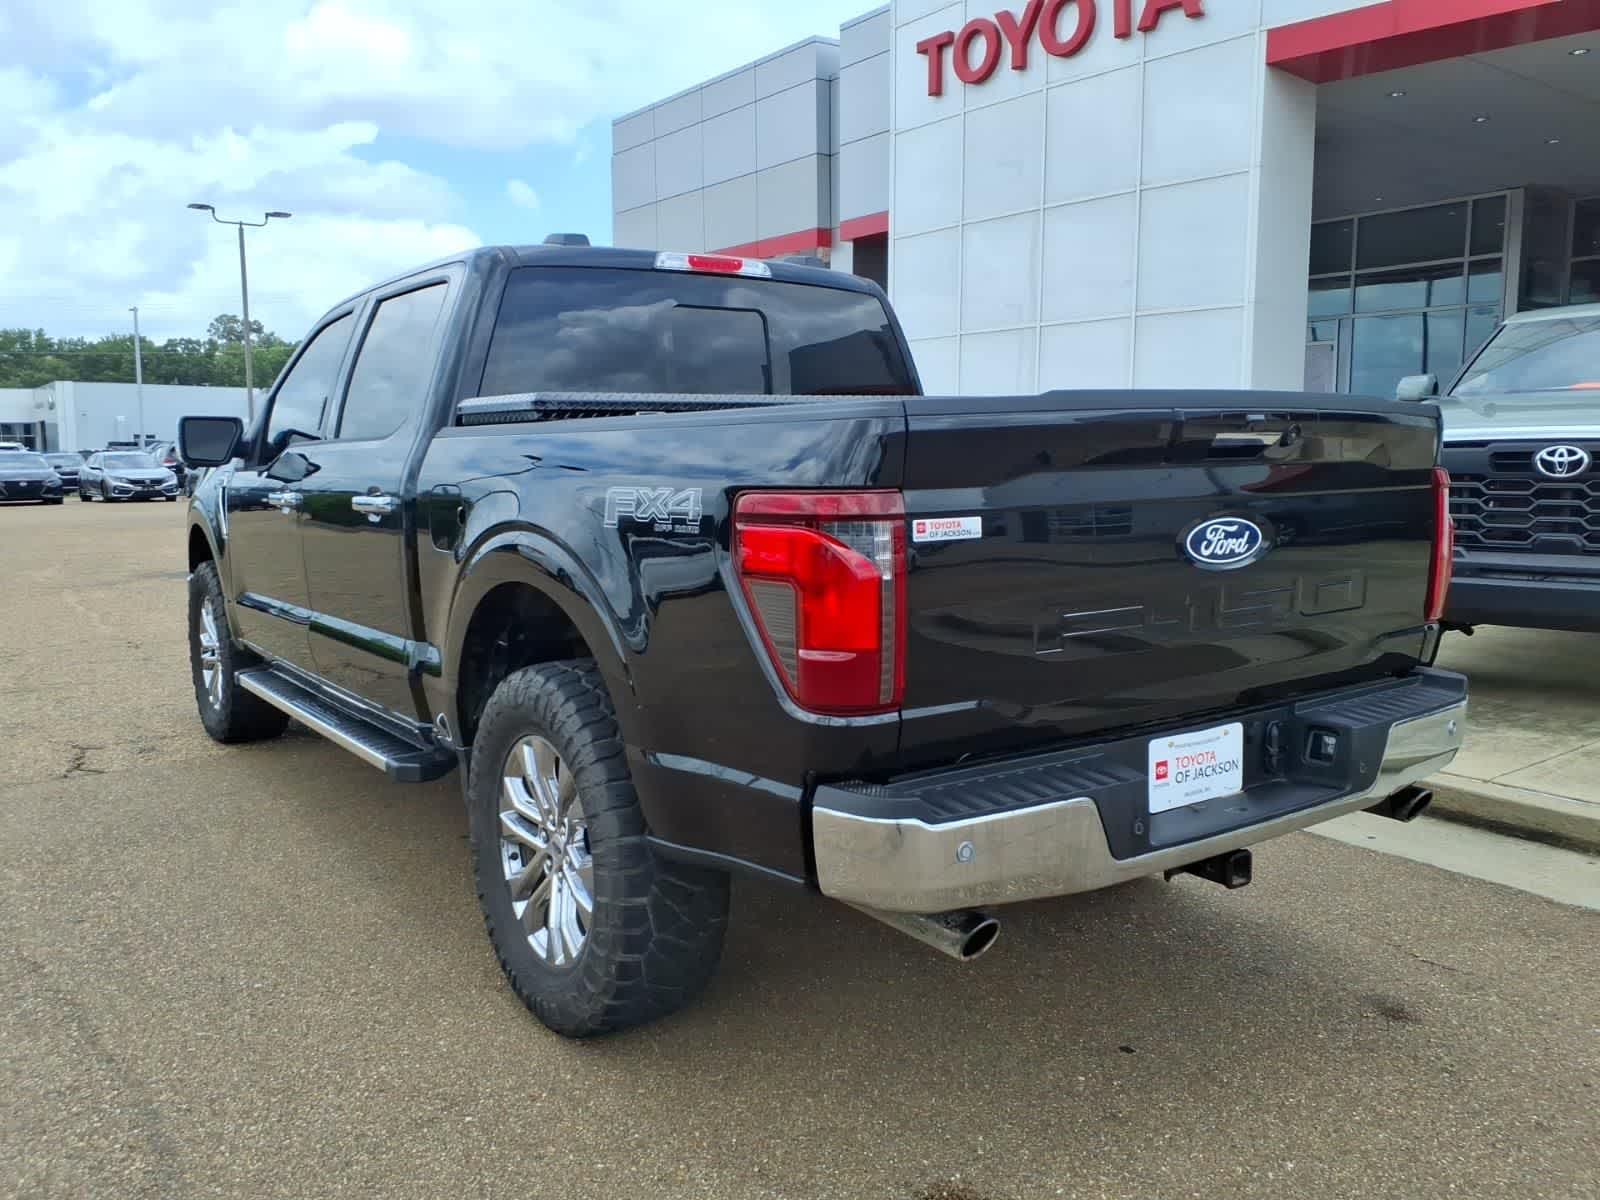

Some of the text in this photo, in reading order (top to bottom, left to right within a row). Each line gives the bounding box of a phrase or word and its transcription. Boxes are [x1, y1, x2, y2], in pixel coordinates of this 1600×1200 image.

[603, 486, 702, 528] FX4
[929, 520, 961, 529] TOYOTA
[929, 530, 938, 538] OF
[1200, 525, 1250, 556] Ford
[1175, 750, 1216, 769] TOYOTA
[1175, 759, 1239, 784] OF JACKSON
